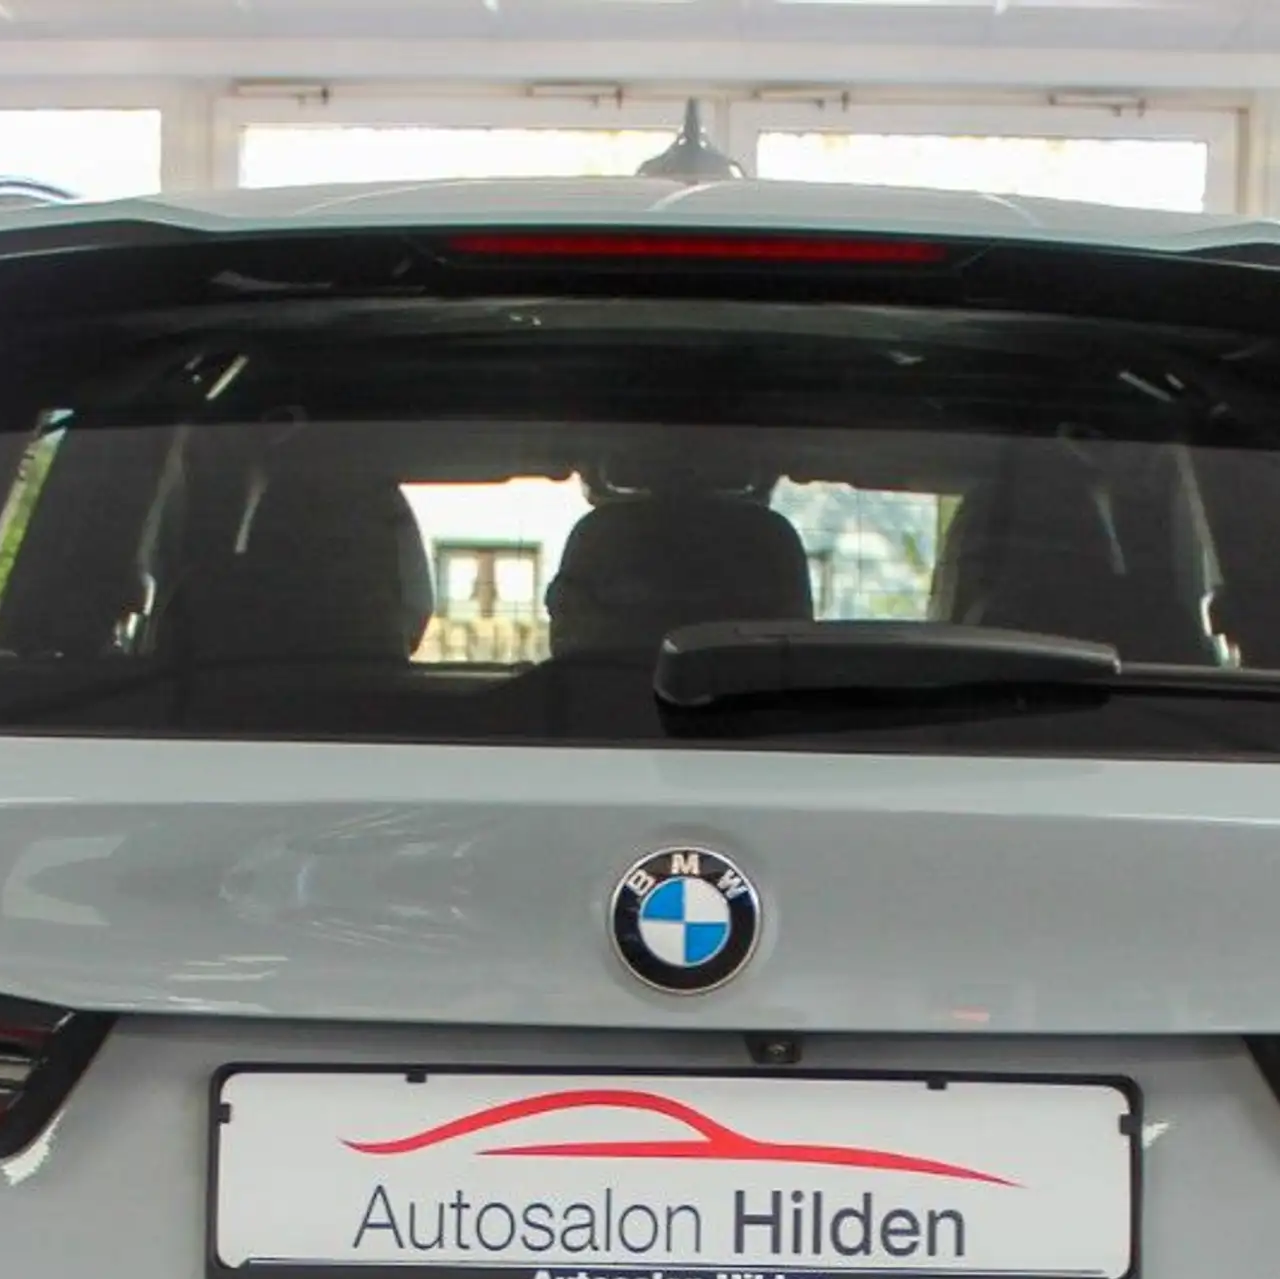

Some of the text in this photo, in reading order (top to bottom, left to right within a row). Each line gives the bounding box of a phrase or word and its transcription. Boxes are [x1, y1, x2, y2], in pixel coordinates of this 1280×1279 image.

[625, 853, 749, 899] BMW
[352, 1183, 966, 1257] Autosalon Hilden
